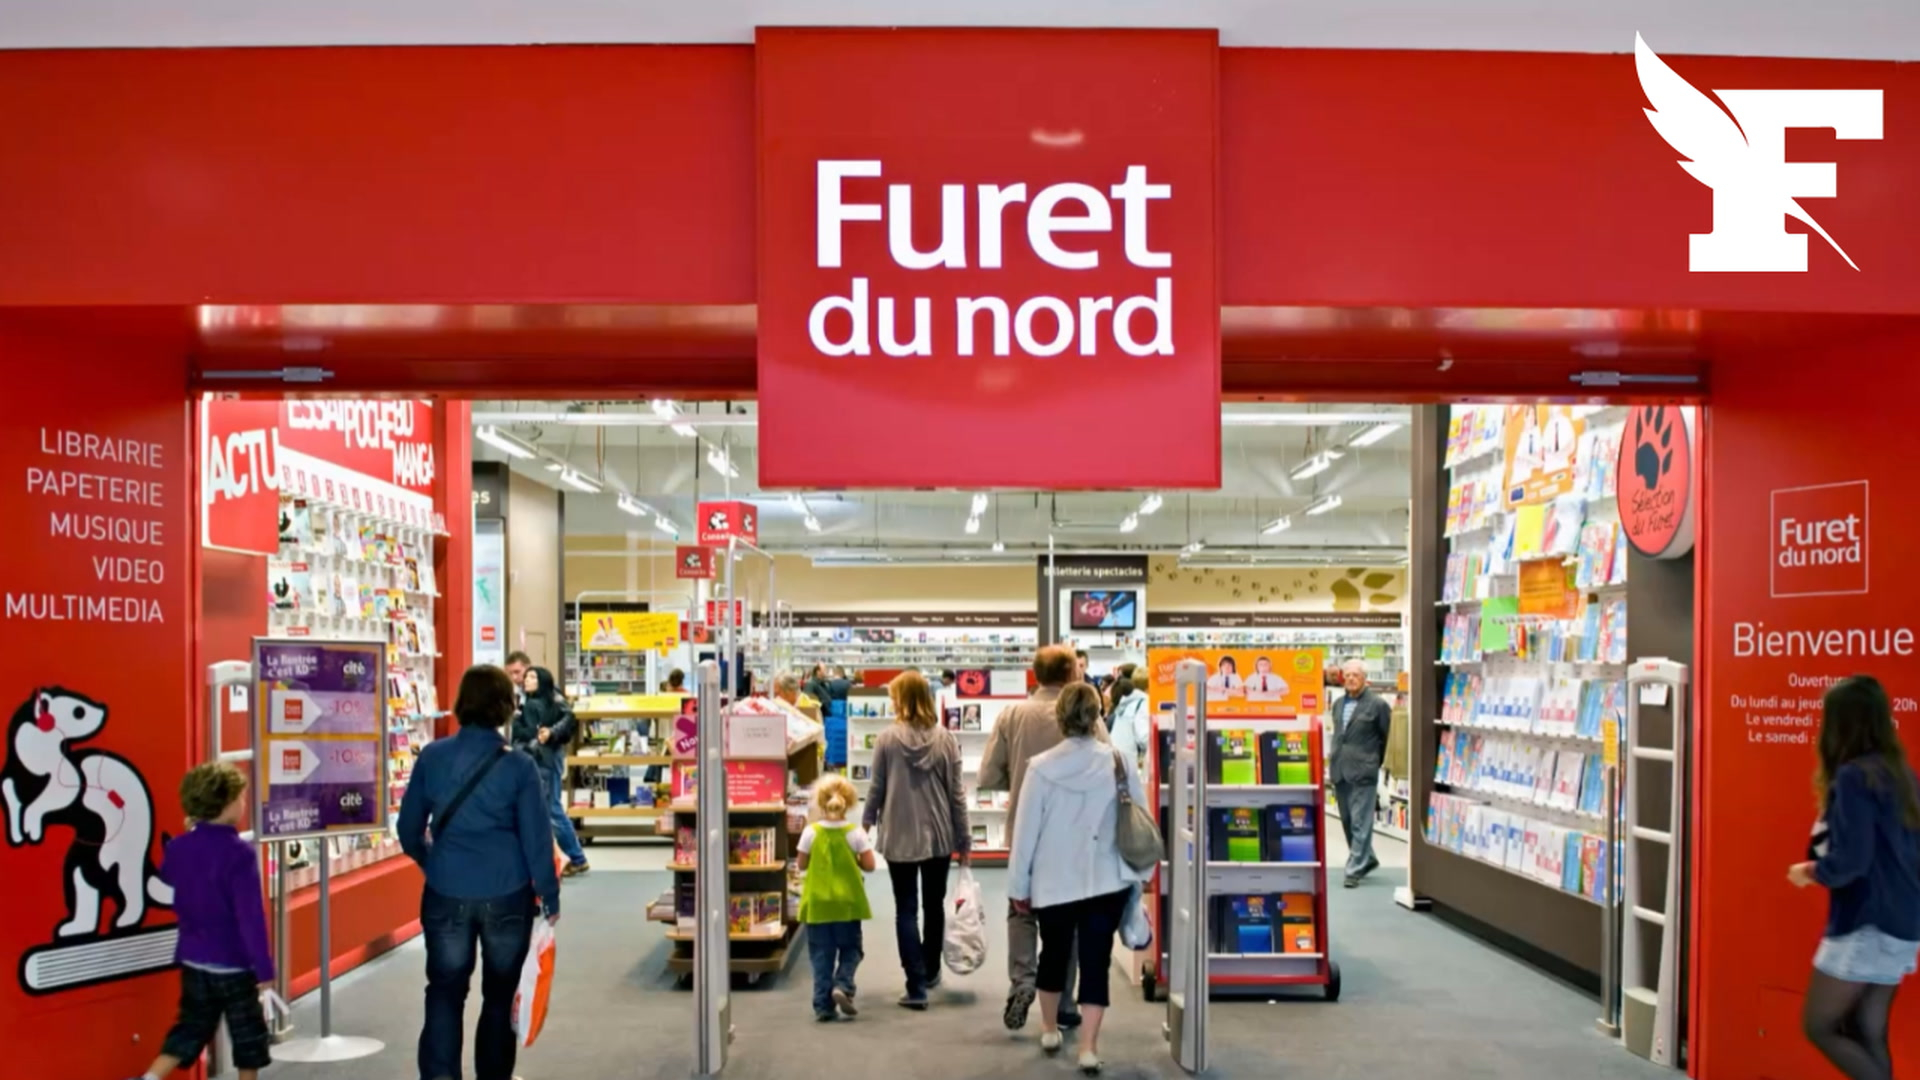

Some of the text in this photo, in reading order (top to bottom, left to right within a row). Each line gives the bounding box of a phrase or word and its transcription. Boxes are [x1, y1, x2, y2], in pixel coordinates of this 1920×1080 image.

[816, 159, 1173, 270] Furet
[808, 277, 1175, 357] du nord
[344, 399, 395, 449] POCHE
[40, 427, 164, 469] LIBRAIRIE
[393, 441, 435, 487] MANGA
[208, 426, 281, 505] ACTU
[26, 467, 164, 507] PAPETERIE
[50, 512, 164, 546] MUSIQUE
[1779, 513, 1861, 546] Furet
[92, 555, 165, 585] VIDEO
[1778, 541, 1861, 568] du nord
[1093, 565, 1143, 579] spectacles
[4, 592, 164, 623] MULTIMEDIA
[1733, 621, 1915, 657] Bienvenue
[266, 654, 279, 667] La
[1788, 672, 1847, 688] Ouvertur
[1731, 694, 1918, 712] Du lundi au jeud 20h
[1745, 712, 1760, 726] Le
[1762, 713, 1814, 727] vendredi
[1748, 729, 1763, 743] Le
[1765, 730, 1809, 745] samedi
[268, 810, 281, 823] La
